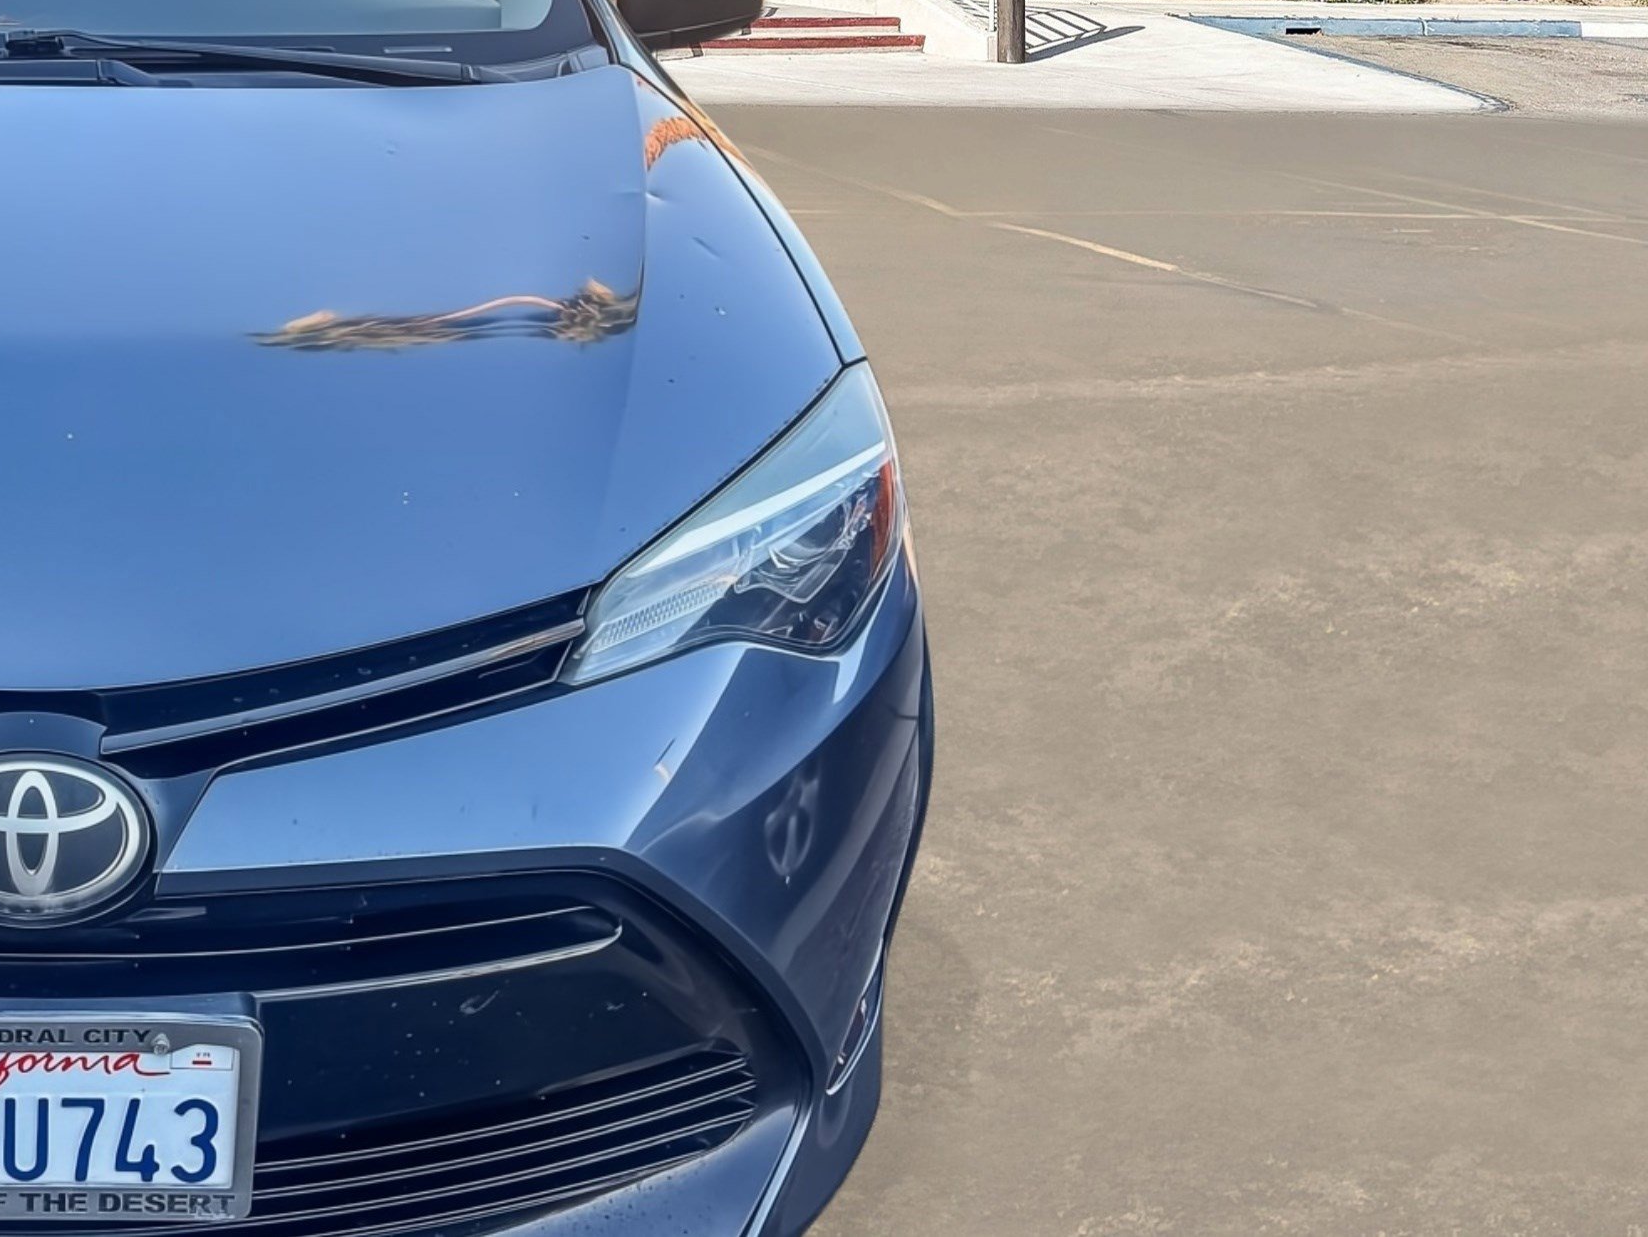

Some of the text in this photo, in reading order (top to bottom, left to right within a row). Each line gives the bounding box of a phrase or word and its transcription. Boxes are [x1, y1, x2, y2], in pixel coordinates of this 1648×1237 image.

[82, 1028, 152, 1044] CITY
[19, 1193, 89, 1213] THE
[98, 1193, 236, 1215] DESERT
